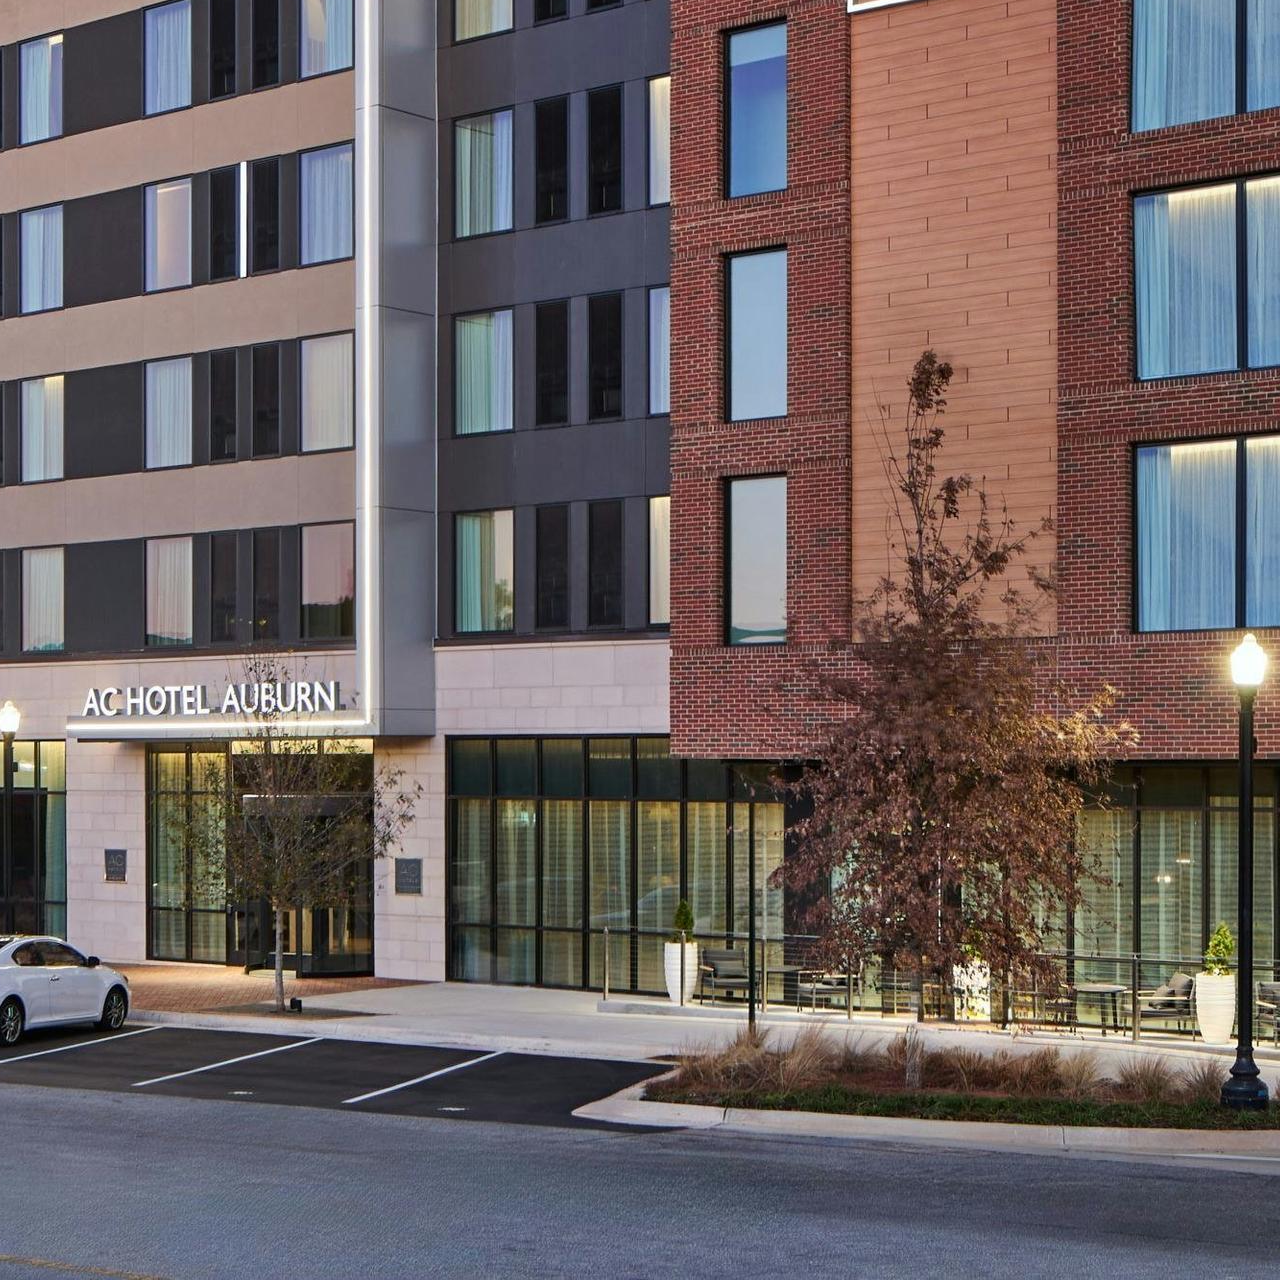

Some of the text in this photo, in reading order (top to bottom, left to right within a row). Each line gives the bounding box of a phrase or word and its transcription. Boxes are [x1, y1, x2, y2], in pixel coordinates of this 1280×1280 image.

[81, 680, 336, 717] AC HOTEL AUBURN
